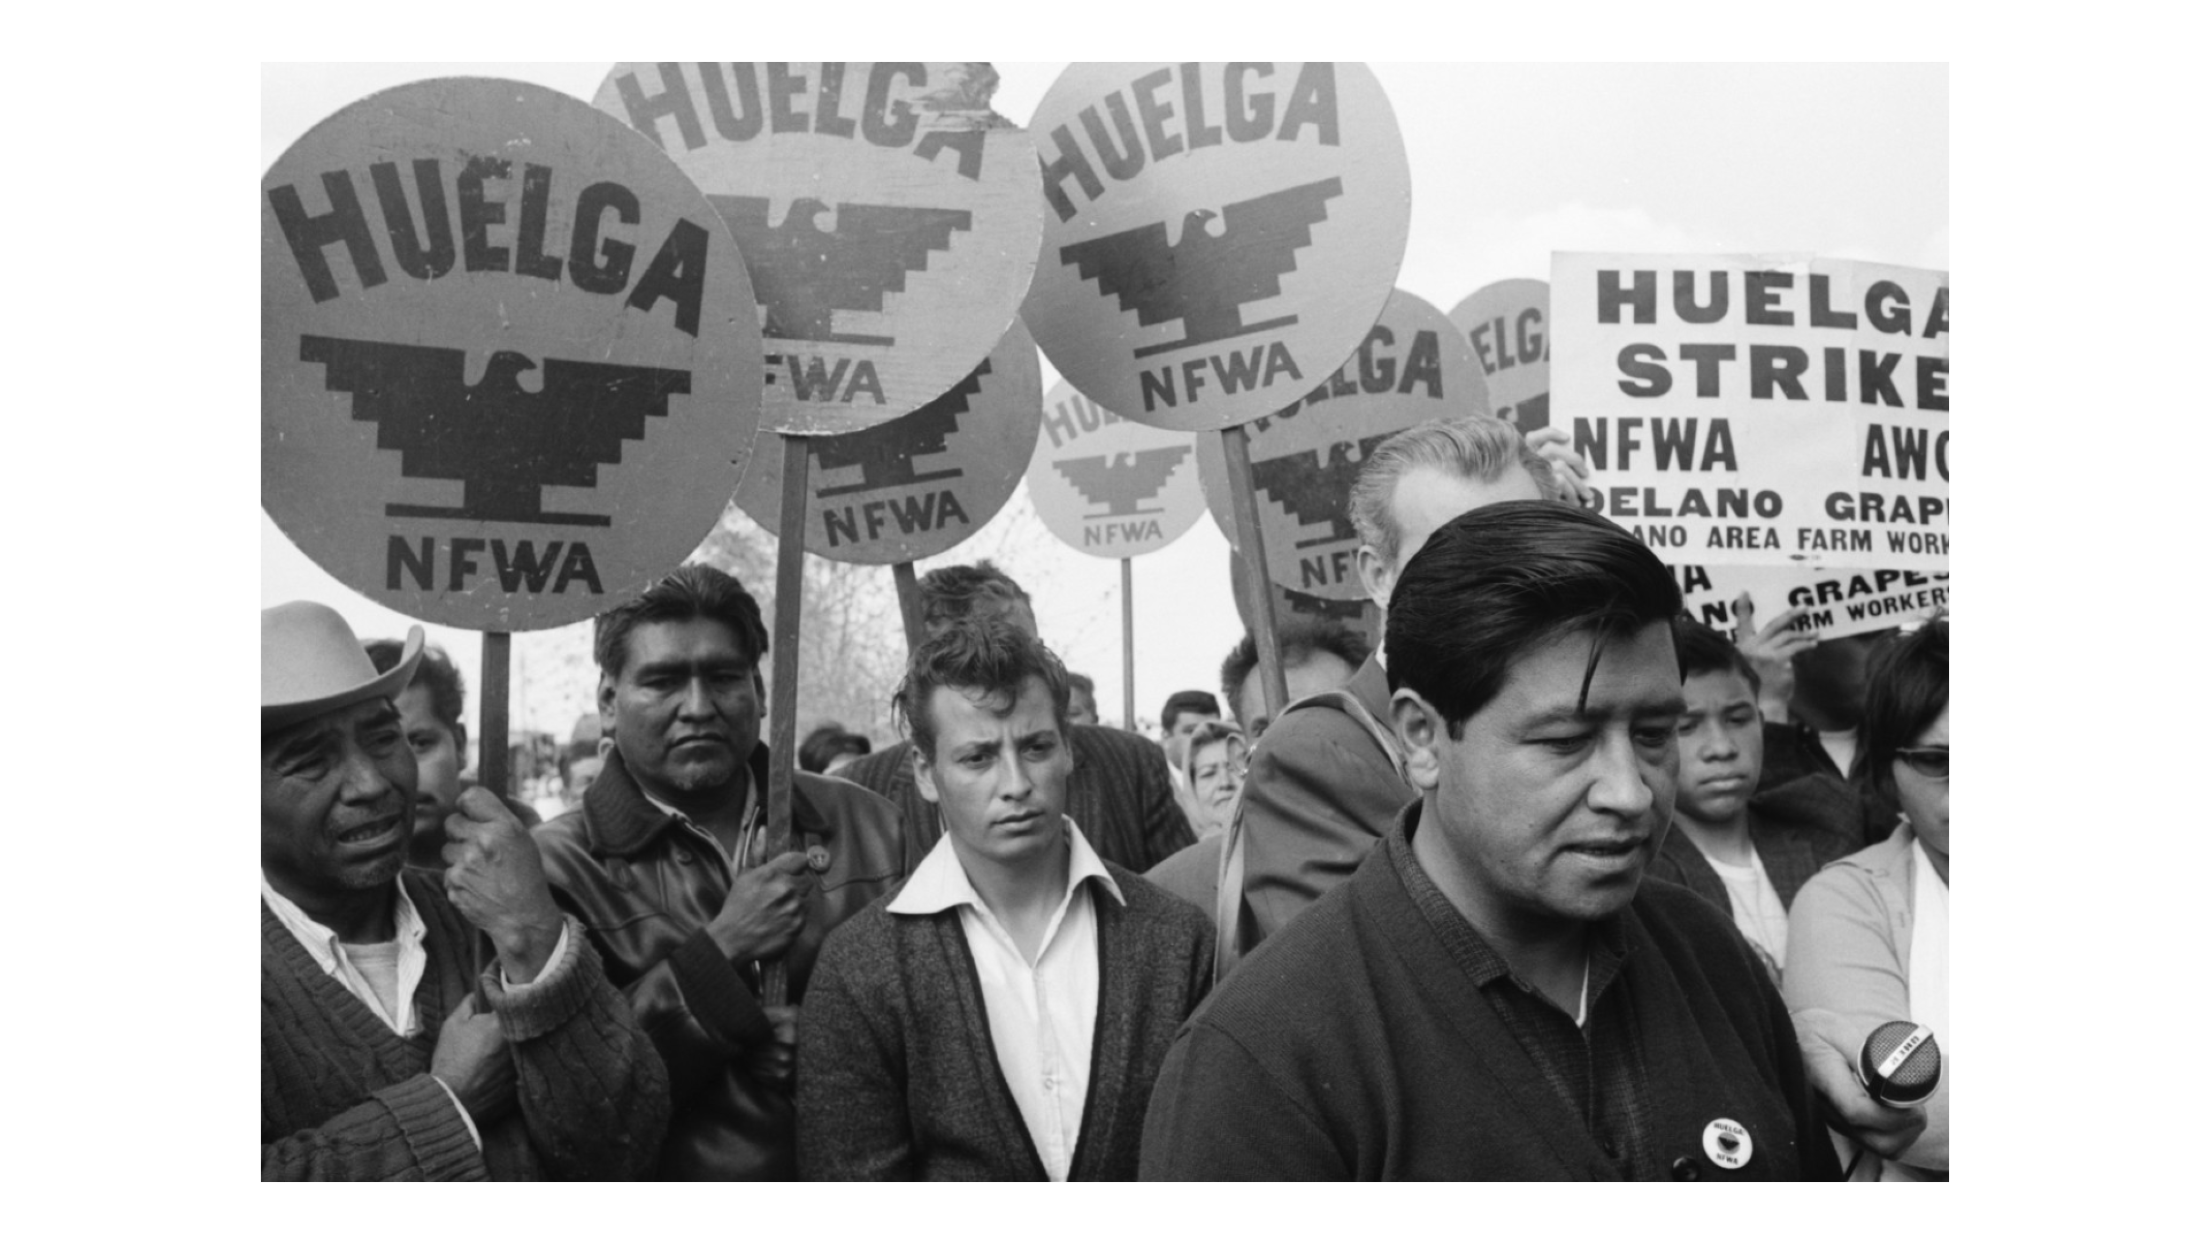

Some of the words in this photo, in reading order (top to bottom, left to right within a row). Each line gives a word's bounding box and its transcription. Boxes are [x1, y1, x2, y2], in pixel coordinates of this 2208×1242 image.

[1038, 61, 1341, 223] HUELGA
[267, 157, 710, 338] HUELGA
[1470, 306, 1550, 377] ELG
[1138, 341, 1304, 413] NFWA
[1617, 342, 1950, 412] STRIKE
[1573, 416, 1738, 472] NFWA
[822, 489, 970, 547] NFWA
[1083, 518, 1164, 547] NFWA
[1825, 491, 1950, 527] GRAP
[385, 534, 605, 595] NFWA
[1706, 526, 1781, 550] AREA
[1798, 528, 1873, 552] FARM
[1300, 548, 1360, 589] NF
[1846, 585, 1950, 622] WORKER
[1713, 1122, 1745, 1137] HUELGA
[1716, 1152, 1739, 1166] NFWA
